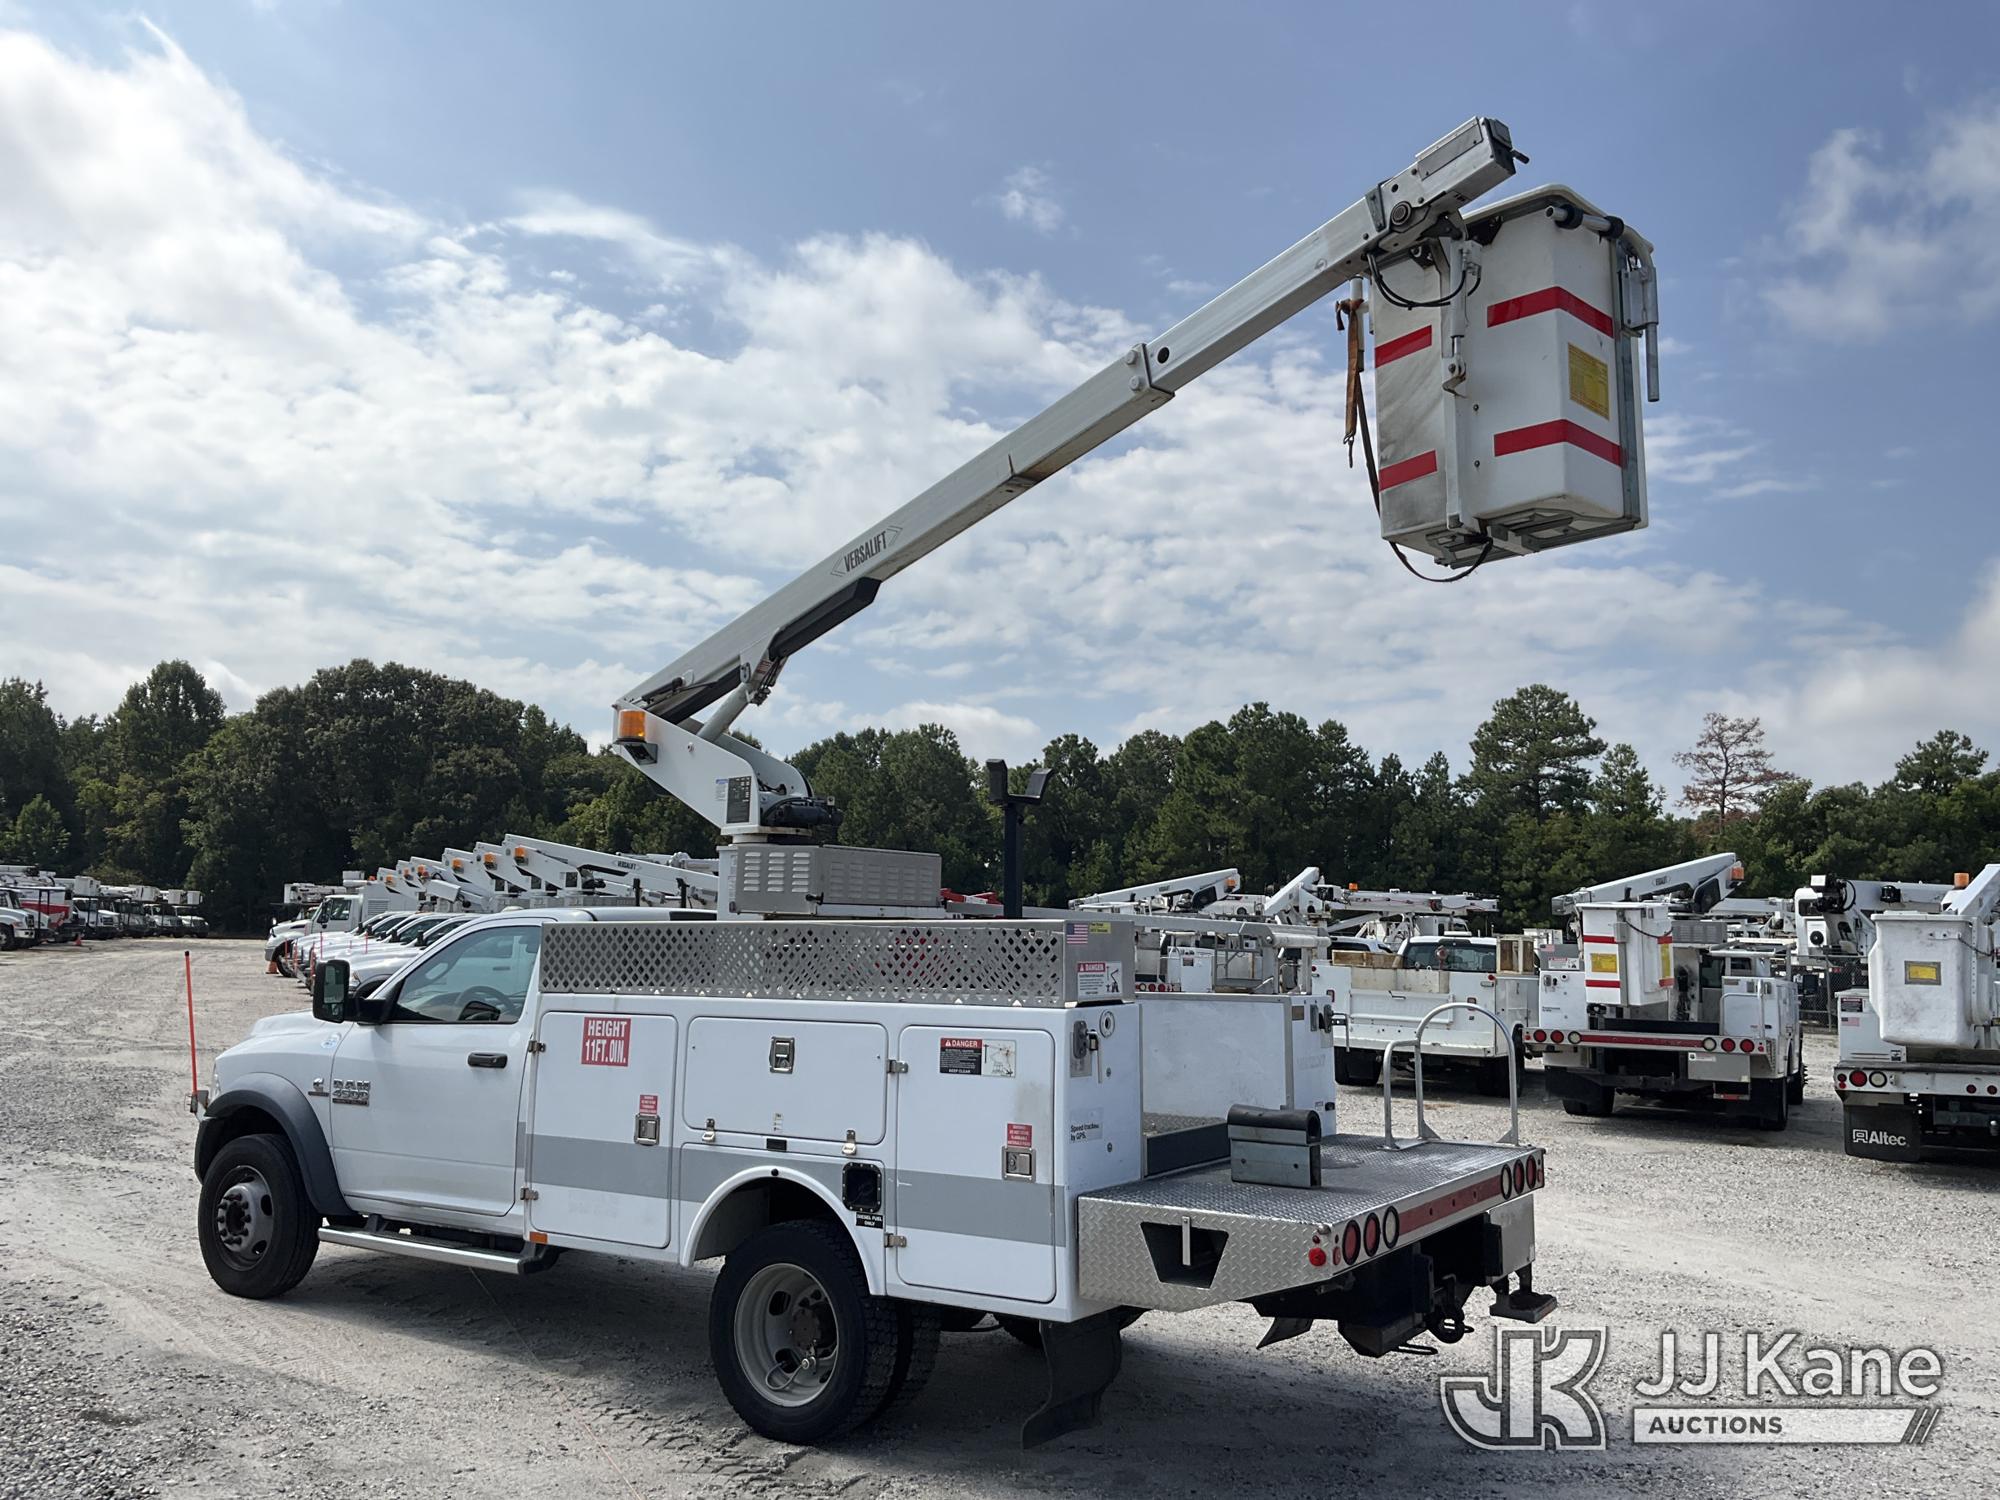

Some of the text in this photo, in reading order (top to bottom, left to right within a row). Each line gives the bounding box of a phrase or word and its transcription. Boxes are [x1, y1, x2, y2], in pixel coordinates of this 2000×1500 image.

[843, 530, 887, 573] VERSALIFT
[587, 1019, 628, 1038] HEIGHT
[951, 1039, 978, 1048] DANGER
[333, 1078, 371, 1091] RAM
[1868, 1130, 1907, 1146] Altec
